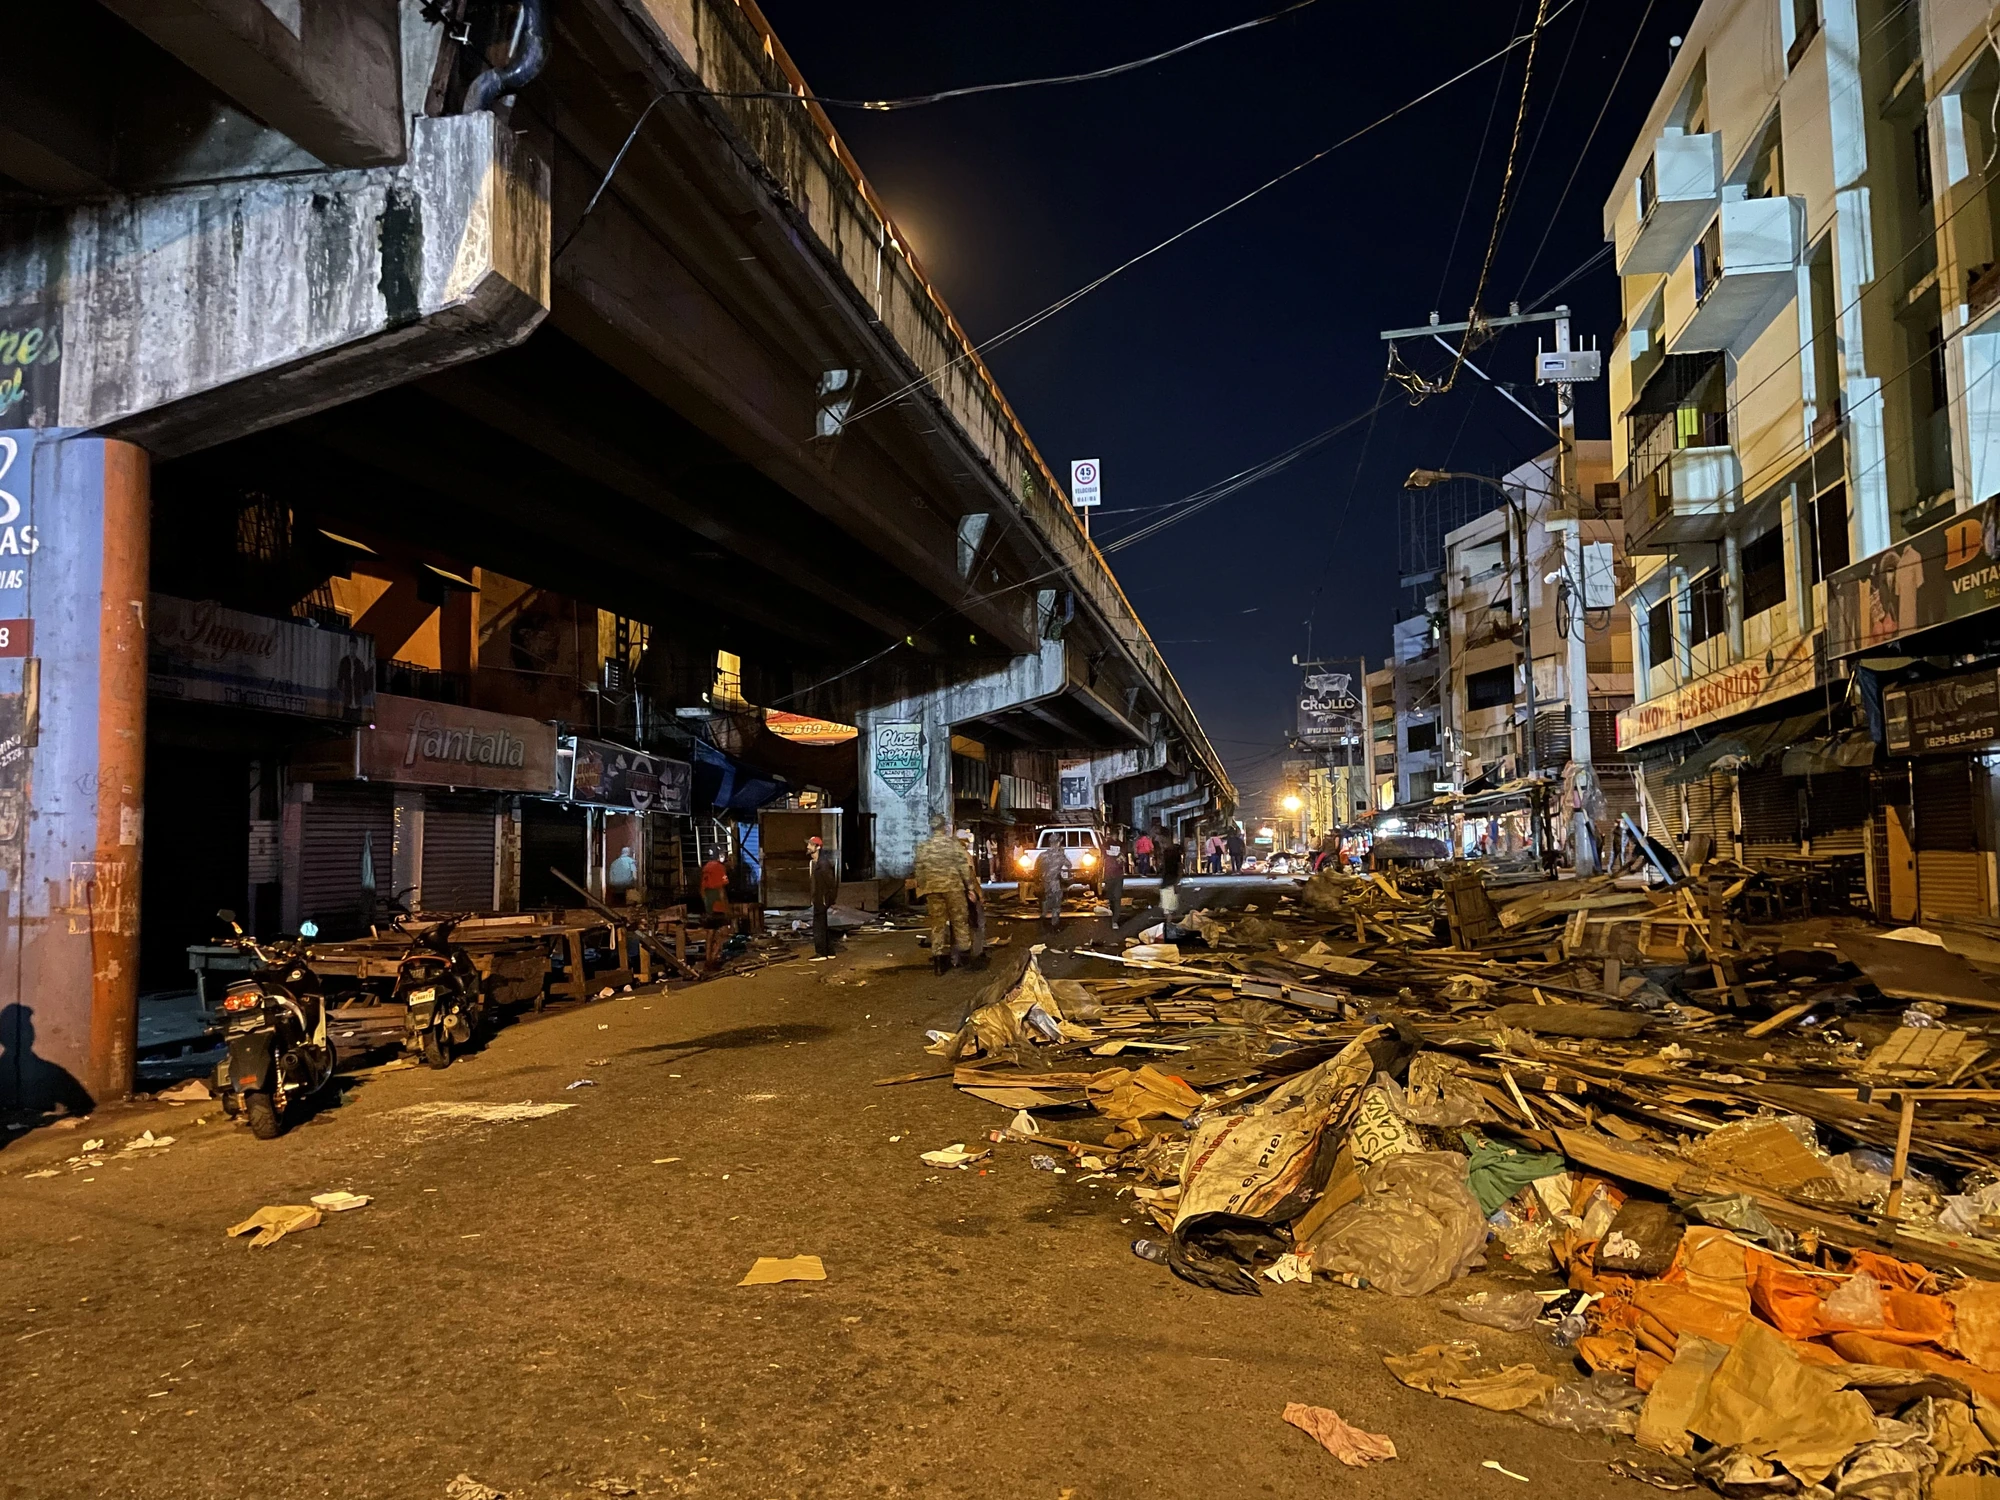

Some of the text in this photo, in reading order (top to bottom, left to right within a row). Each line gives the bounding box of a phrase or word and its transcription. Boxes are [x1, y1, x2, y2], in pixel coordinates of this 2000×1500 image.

[1080, 467, 1092, 476] 45
[1952, 564, 2000, 595] VENTA
[1300, 698, 1355, 710] CRIOLLO
[1677, 665, 1761, 721] ACCESORIOS
[403, 709, 525, 768] fantalia
[1258, 1134, 1282, 1169] Piel
